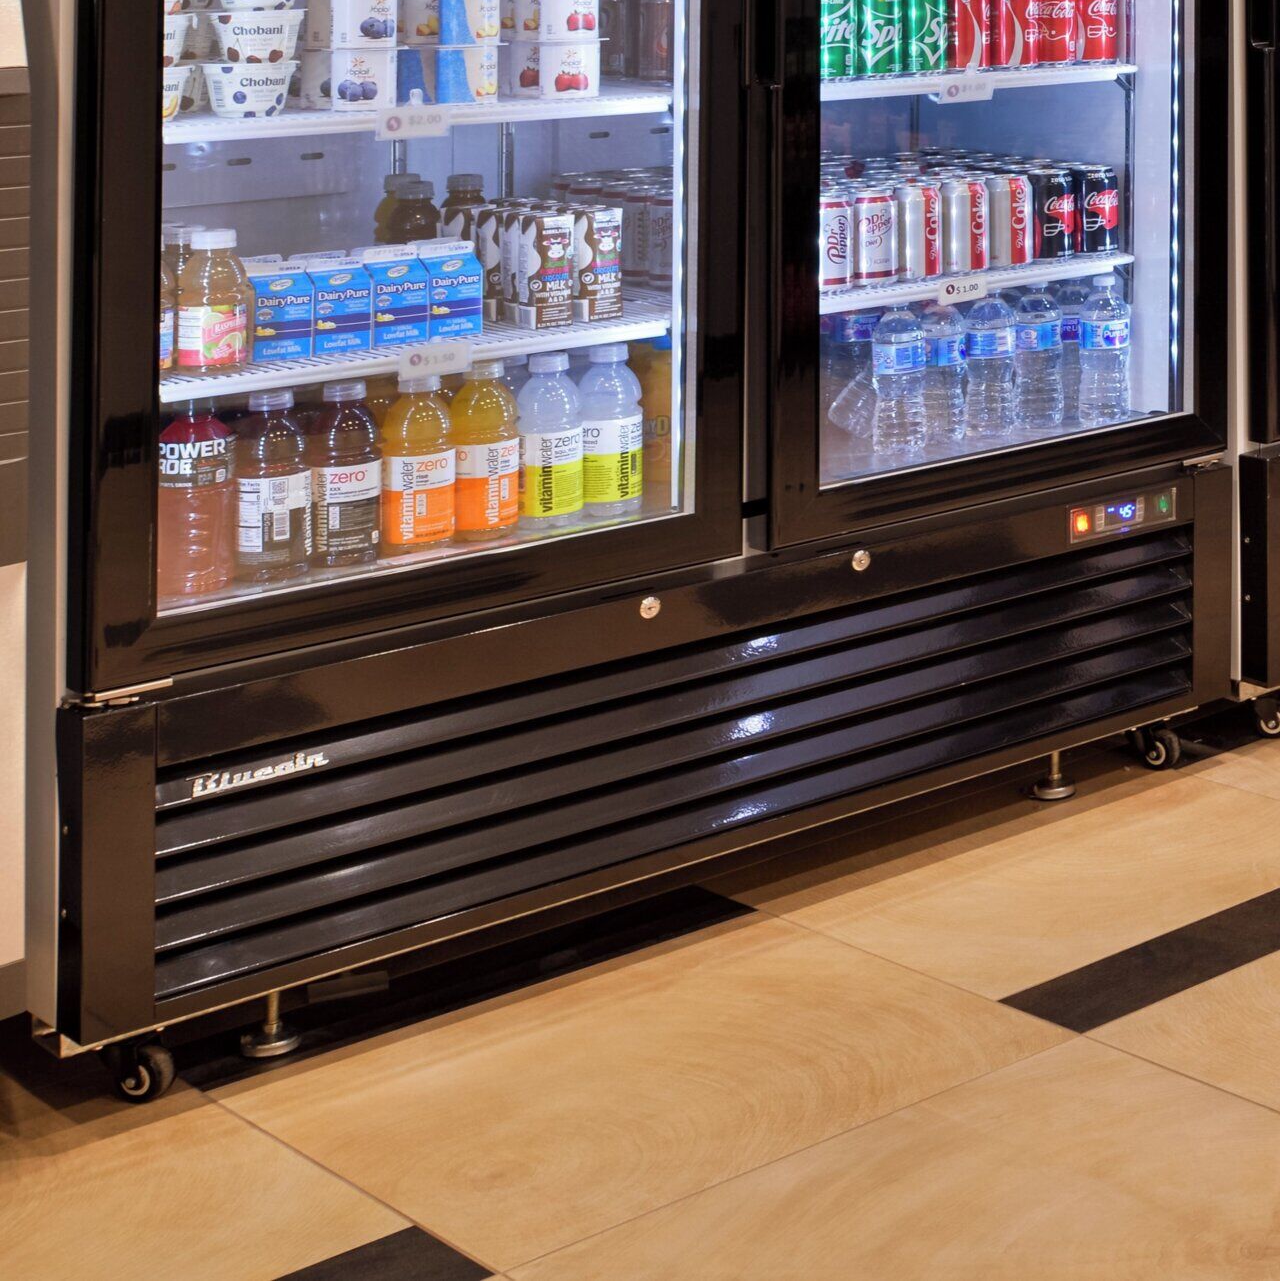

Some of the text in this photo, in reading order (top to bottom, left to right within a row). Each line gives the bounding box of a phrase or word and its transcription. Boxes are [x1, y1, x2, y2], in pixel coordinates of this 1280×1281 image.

[232, 24, 283, 36] Chobani
[240, 75, 286, 87] Chobani
[1011, 182, 1024, 228] Coke
[972, 190, 985, 235] Coke
[925, 199, 939, 243] Coke
[377, 281, 426, 294] DairyPure
[432, 274, 480, 288] DairyPure
[963, 283, 979, 293] 1.00
[257, 295, 310, 308] DairyPure
[318, 288, 369, 302] DairyPure
[416, 458, 448, 472] zero
[329, 469, 366, 485] zero
[541, 437, 553, 514] vitaminwater
[486, 447, 499, 525] vitaminwater
[401, 461, 414, 541] vitaminwater
